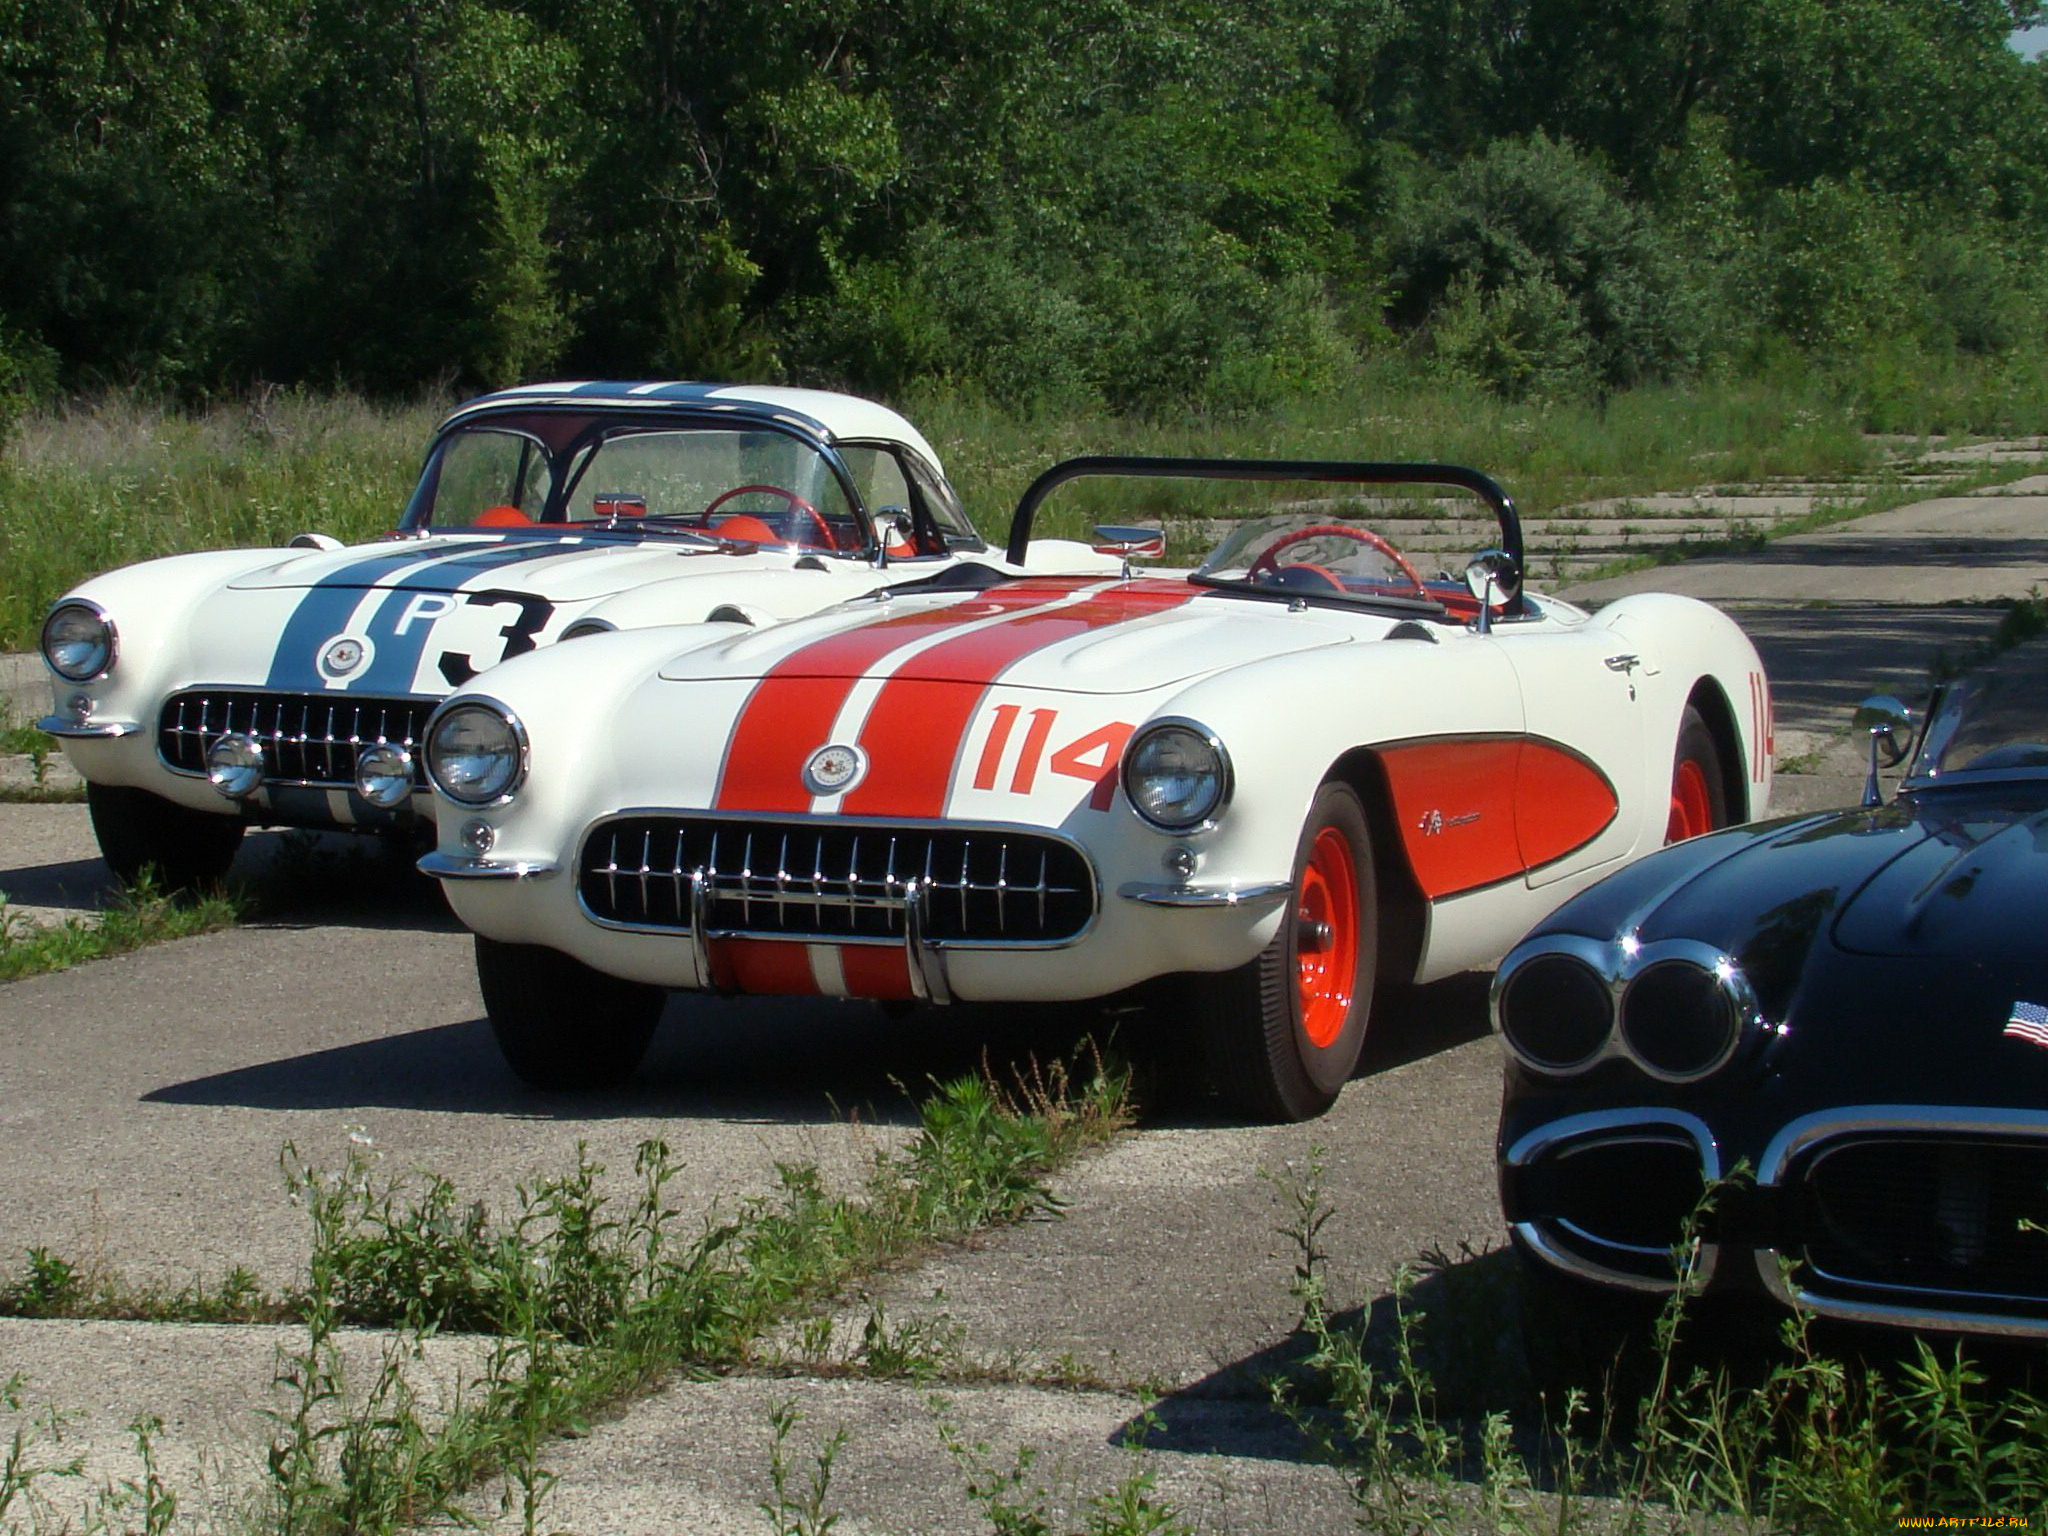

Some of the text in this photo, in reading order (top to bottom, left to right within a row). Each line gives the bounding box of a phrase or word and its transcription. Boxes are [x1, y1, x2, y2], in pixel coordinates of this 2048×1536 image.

[394, 588, 555, 688] P 3
[972, 704, 1136, 812] 114
